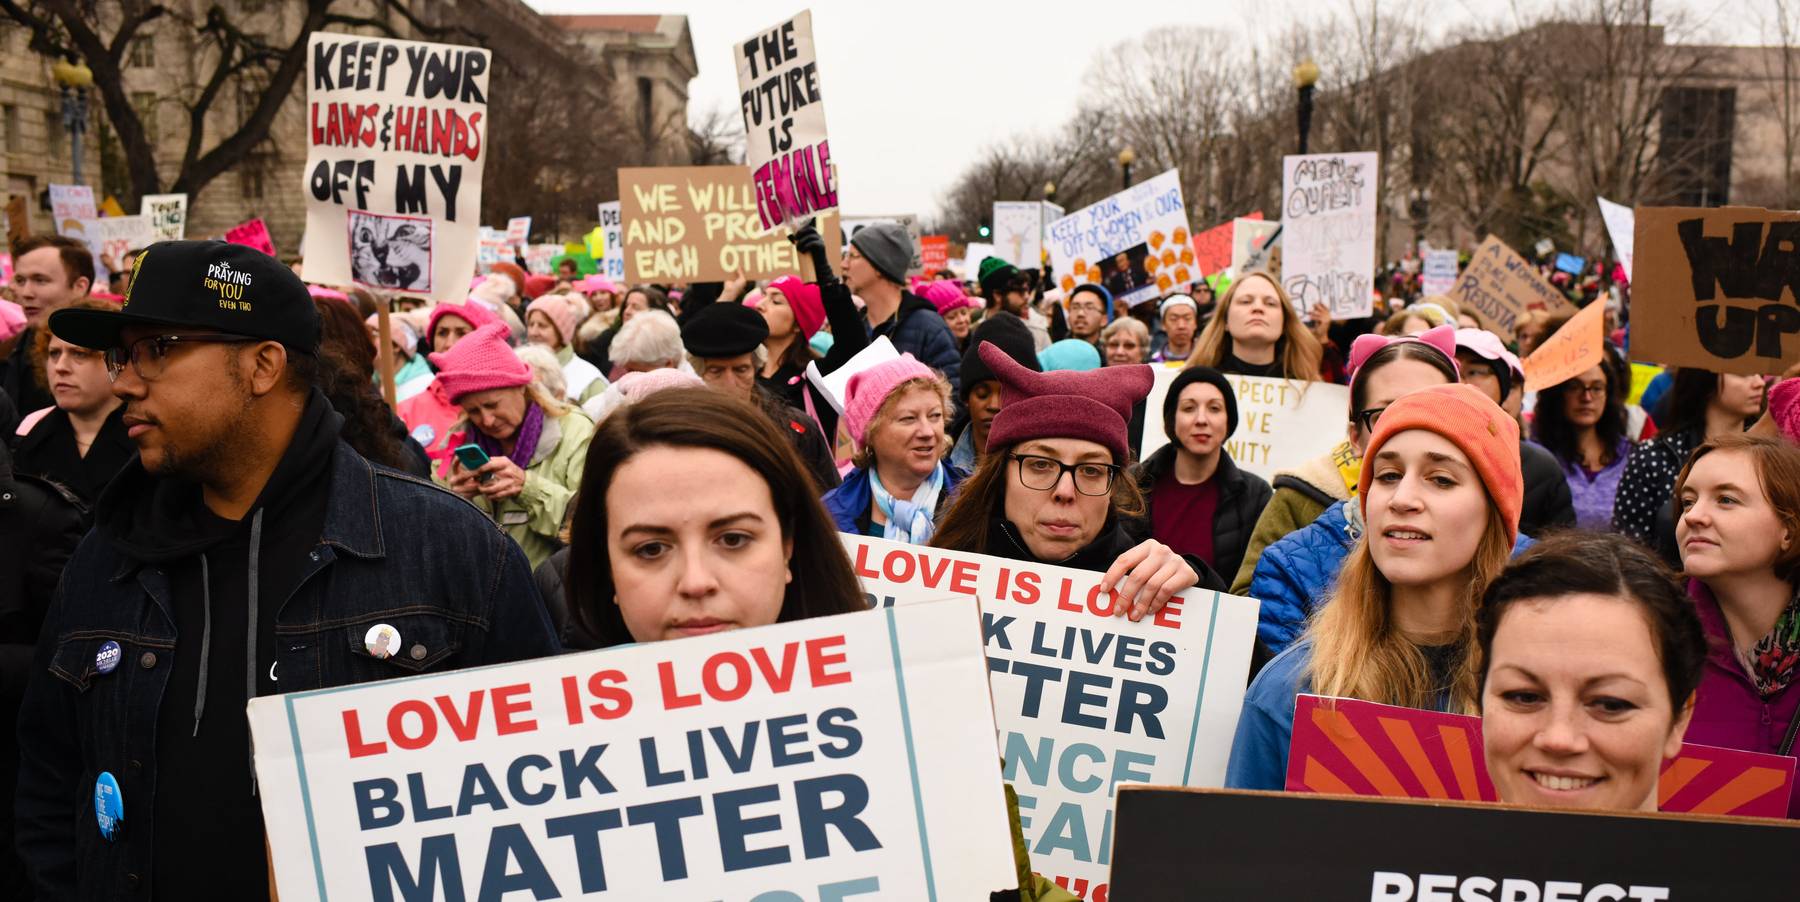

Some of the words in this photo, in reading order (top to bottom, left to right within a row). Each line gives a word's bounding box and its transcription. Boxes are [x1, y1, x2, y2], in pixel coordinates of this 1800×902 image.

[315, 41, 399, 91] KEEP
[405, 45, 487, 104] YOUR
[743, 20, 797, 80] THE
[742, 62, 821, 133] FUTURE
[312, 102, 380, 148] LAWS
[380, 104, 394, 152] &
[394, 106, 482, 162] HANDS
[769, 118, 793, 156] IS
[311, 160, 375, 210] OFF
[395, 165, 462, 222] MY
[633, 184, 682, 213] WE
[687, 179, 756, 213] WILL
[753, 140, 838, 231] FEMALE
[1294, 158, 1346, 185] MEN
[627, 216, 685, 246] AND
[704, 211, 833, 243] PROT
[1051, 216, 1080, 241] KEEP
[1089, 198, 1121, 225] YOUR
[1063, 232, 1084, 258] OFF
[1104, 211, 1142, 236] WOMEN
[1155, 188, 1182, 217] OUR
[1099, 230, 1141, 260] RIGHTS
[207, 263, 252, 286] PRAYING
[635, 244, 699, 279] EACH
[1488, 244, 1500, 258] A
[1677, 218, 1800, 306] WA
[204, 277, 219, 290] FOR
[219, 282, 243, 300] YOU
[219, 299, 236, 310] EVEN
[239, 301, 252, 312] THO
[1458, 275, 1517, 334] RESISTA
[1695, 304, 1800, 359] UP
[1231, 381, 1289, 406] PECT
[1246, 412, 1273, 434] VE
[1227, 441, 1271, 465] NITY
[855, 544, 981, 595] LOVE
[995, 567, 1042, 605] IS
[1058, 577, 1185, 630] LOE
[96, 648, 118, 661] 2020
[1030, 620, 1177, 676] LIVES
[342, 682, 538, 758] LOVE
[561, 670, 634, 725] IS
[657, 635, 853, 711] LOVE
[987, 656, 1167, 740] TER
[352, 743, 617, 831] BLACK
[639, 707, 864, 788] LIVES
[998, 730, 1156, 798] NCE
[364, 772, 884, 902] MATTER
